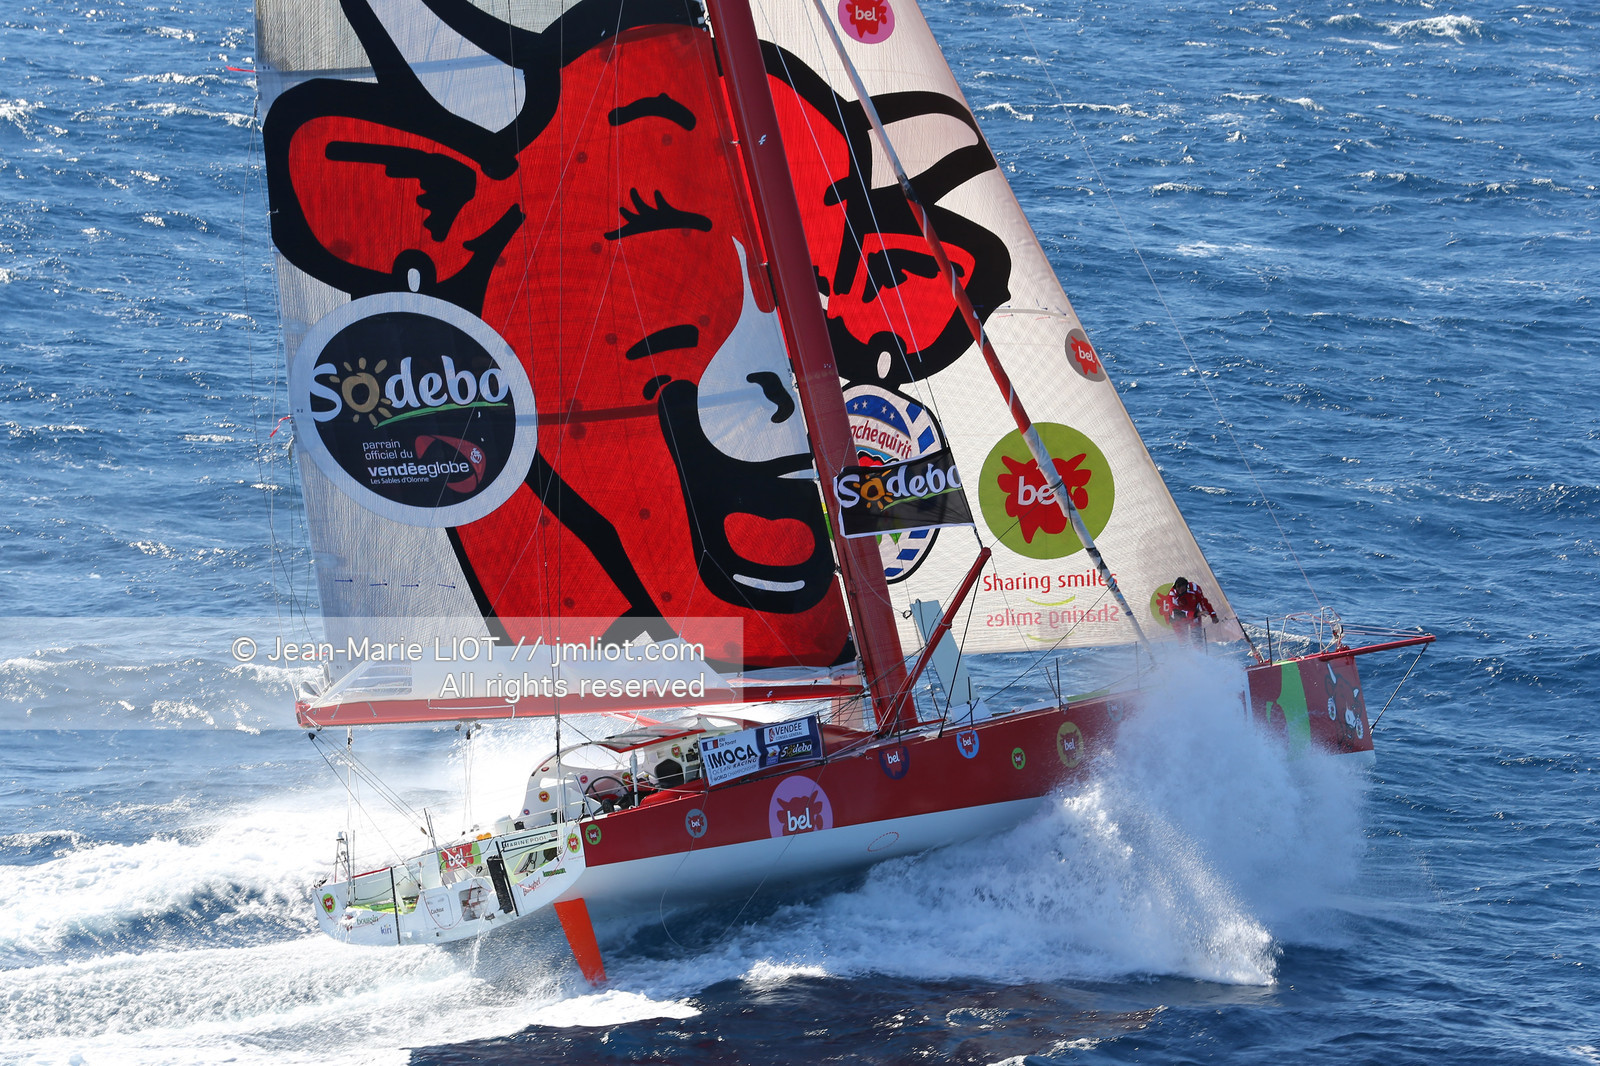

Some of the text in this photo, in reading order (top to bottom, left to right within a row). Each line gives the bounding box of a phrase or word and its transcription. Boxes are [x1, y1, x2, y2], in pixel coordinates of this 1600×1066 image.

[855, 5, 877, 21] bel
[1078, 345, 1095, 363] bel
[310, 355, 509, 422] Sodebo
[362, 439, 400, 452] parrain
[364, 449, 413, 460] officiel du
[381, 477, 400, 485] Sables
[401, 476, 429, 484] d'Olonne
[838, 463, 961, 508] Sodebo
[1017, 475, 1063, 505] be
[983, 573, 1051, 594] Sharing
[708, 744, 758, 769] IMOCA
[781, 742, 812, 757] Sodebo
[886, 750, 900, 764] bel
[733, 757, 757, 768] RACING
[713, 773, 728, 781] WORLD
[787, 807, 812, 832] bel
